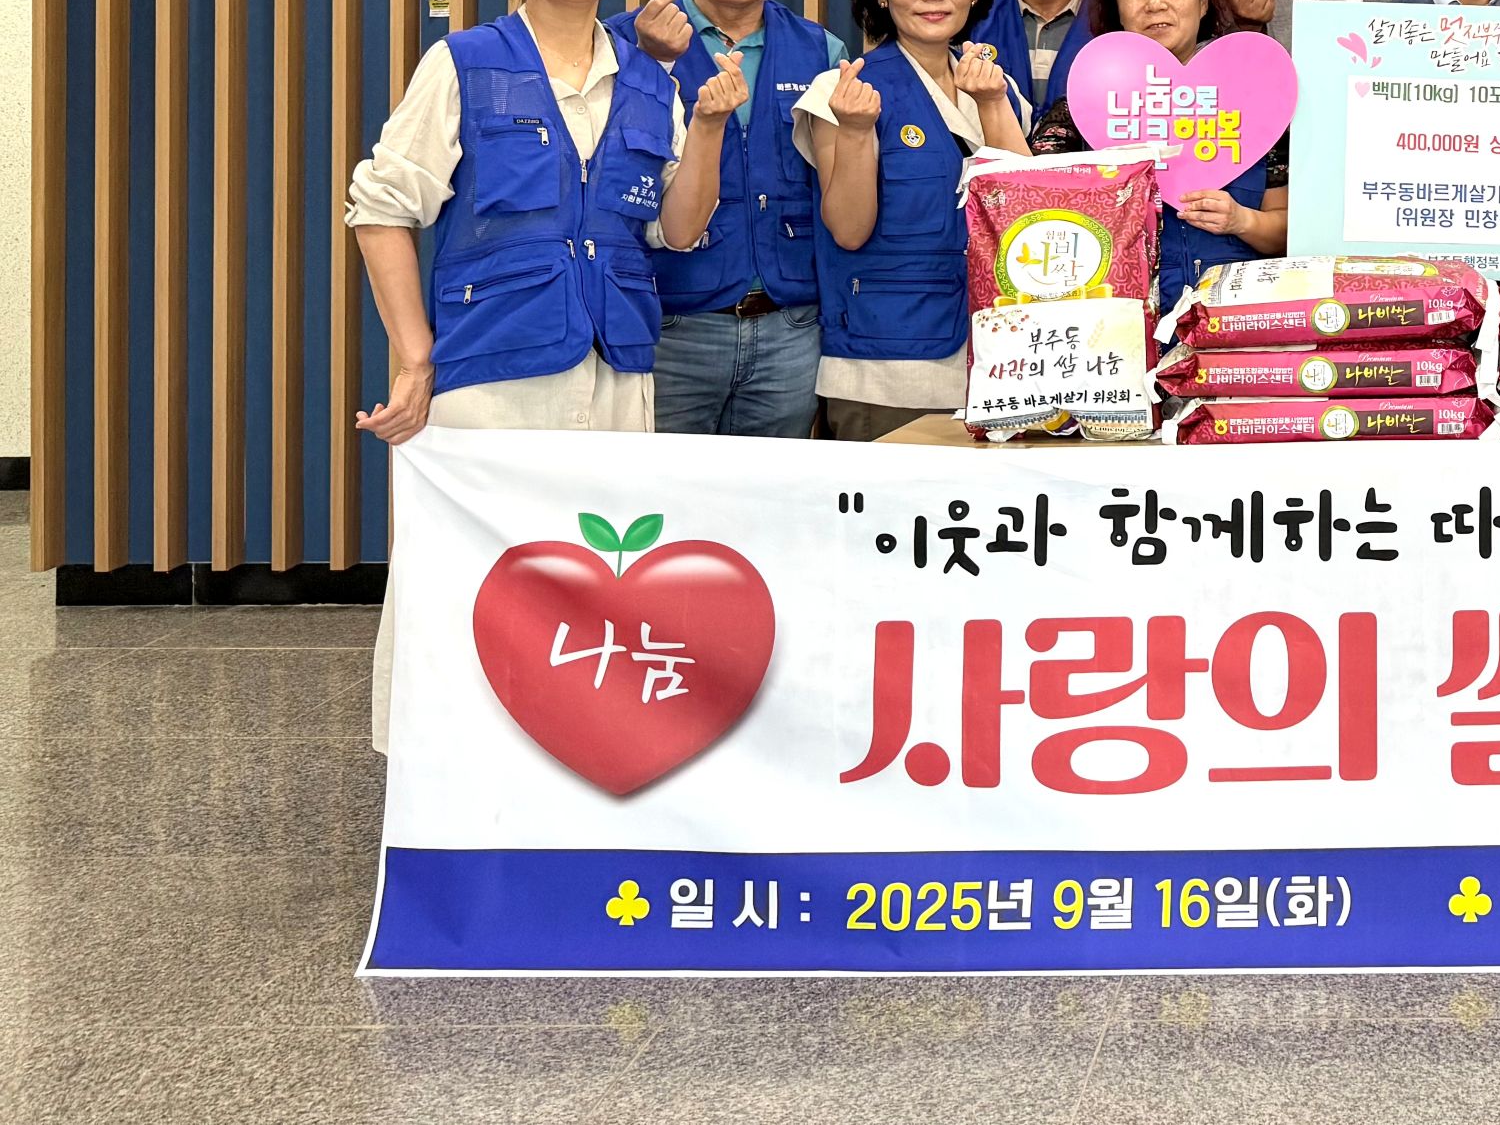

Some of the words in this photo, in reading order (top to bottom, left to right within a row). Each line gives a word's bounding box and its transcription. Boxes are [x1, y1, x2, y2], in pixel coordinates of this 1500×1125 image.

[1367, 18, 1436, 45] 살기좋은
[1430, 48, 1492, 73] 만들어요
[1107, 64, 1219, 117] 나눔으로
[1396, 132, 1480, 154] 400,000원
[630, 185, 656, 201] 목포시
[1395, 208, 1455, 229] [위원장
[1428, 299, 1454, 309] 10kg
[1222, 318, 1307, 332] 나비라이스센터
[1358, 306, 1417, 326] 나비쌀
[1028, 326, 1081, 354] 부주동
[989, 358, 1045, 381] 사랑의
[1053, 353, 1078, 379] 쌀
[1086, 351, 1124, 376] 나눔
[1345, 365, 1405, 386] 나비쌀
[1416, 361, 1443, 372] 10kg
[1209, 374, 1293, 385] 나비라이스센터
[982, 396, 1020, 413] 부주동
[1024, 389, 1088, 408] 바르게살기
[1092, 389, 1131, 404] 위원회
[1367, 413, 1427, 435] 나비쌀
[1438, 409, 1465, 420] 10kg
[1230, 423, 1315, 435] 나비라이스센터
[1099, 488, 1399, 565] 함께하는
[549, 618, 697, 705] 나눔
[839, 611, 1378, 795] 사랑의
[846, 878, 1034, 931] 2025년
[1052, 876, 1133, 928] 9월
[1155, 874, 1352, 928] 16일(화)
